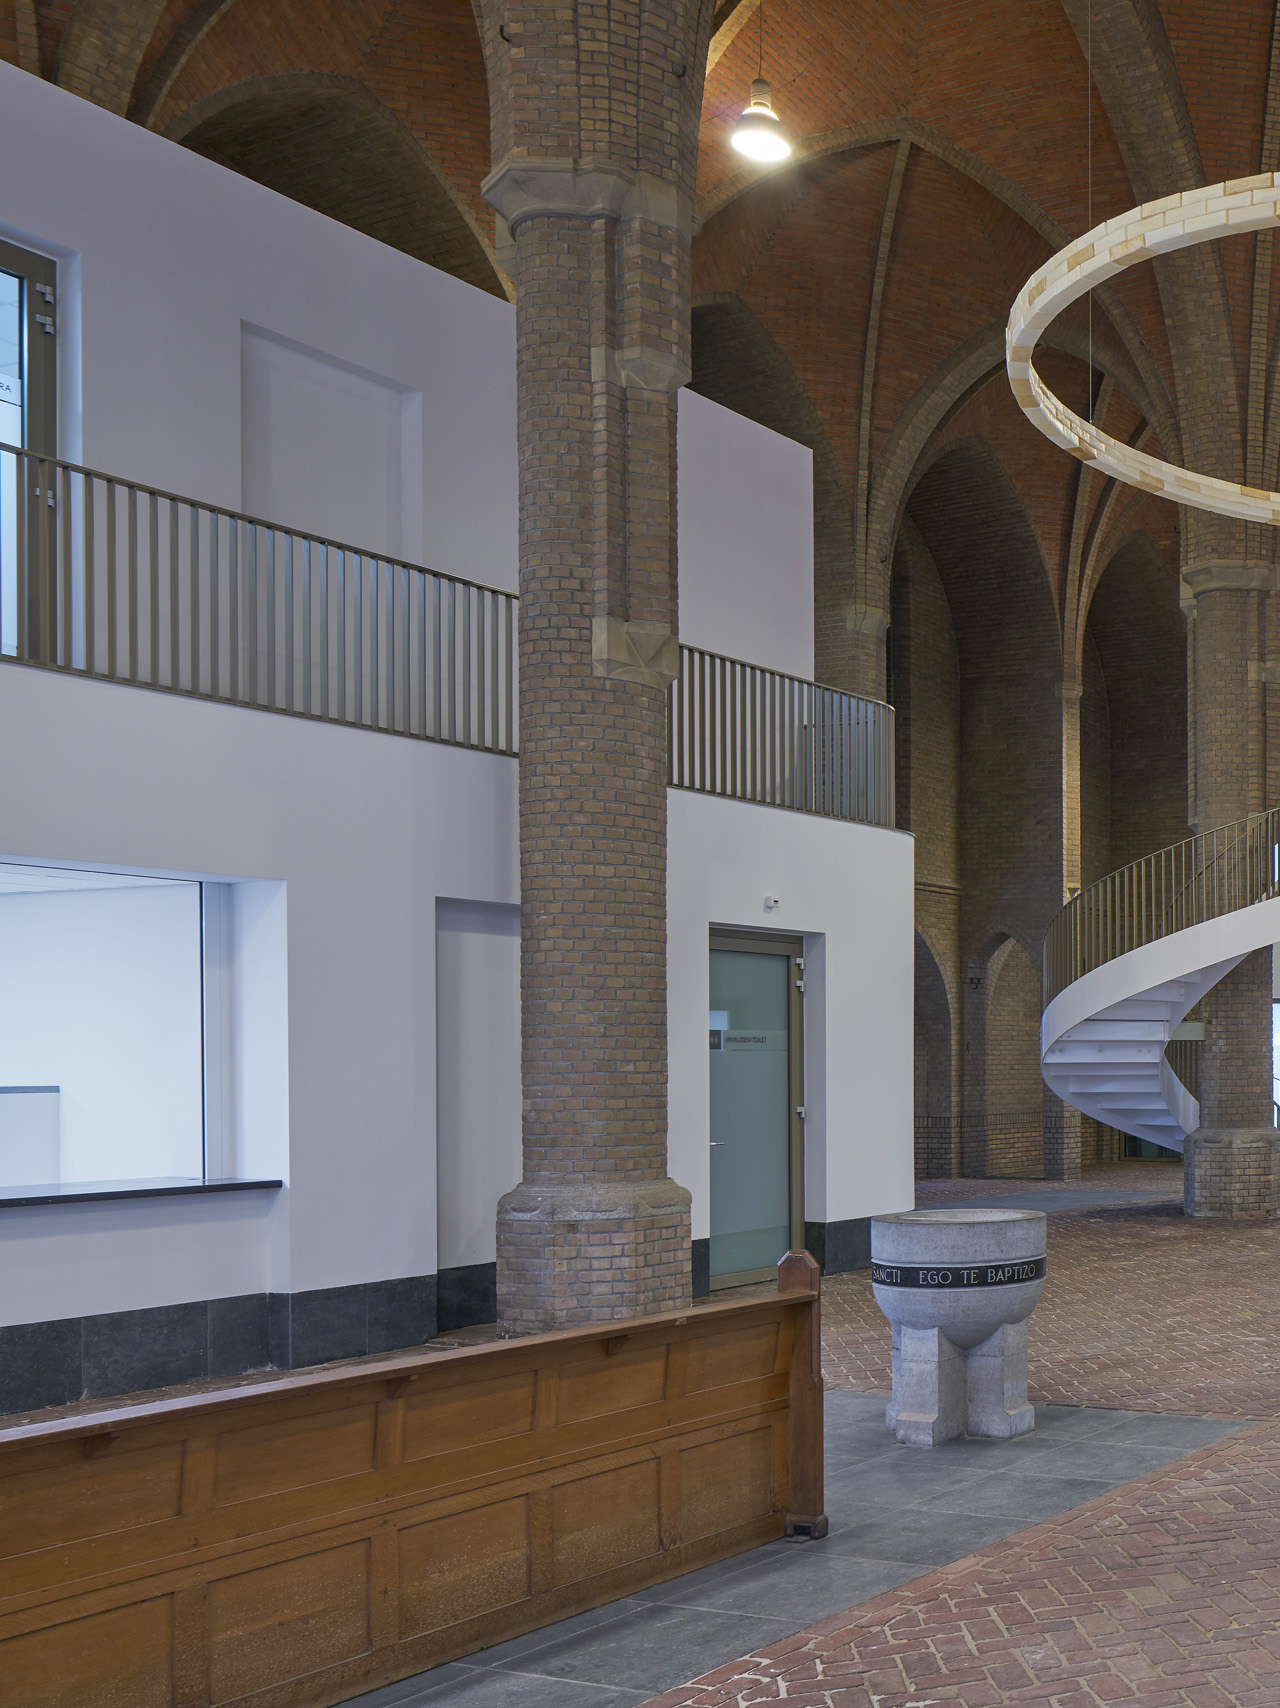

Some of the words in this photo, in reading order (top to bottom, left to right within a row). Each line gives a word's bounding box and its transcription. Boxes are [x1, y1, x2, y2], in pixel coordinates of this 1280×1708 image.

[872, 1266, 901, 1283] SANCTI
[919, 1269, 952, 1285] EGO
[960, 1269, 980, 1284] TE
[987, 1264, 1036, 1283] BAPTIZO
